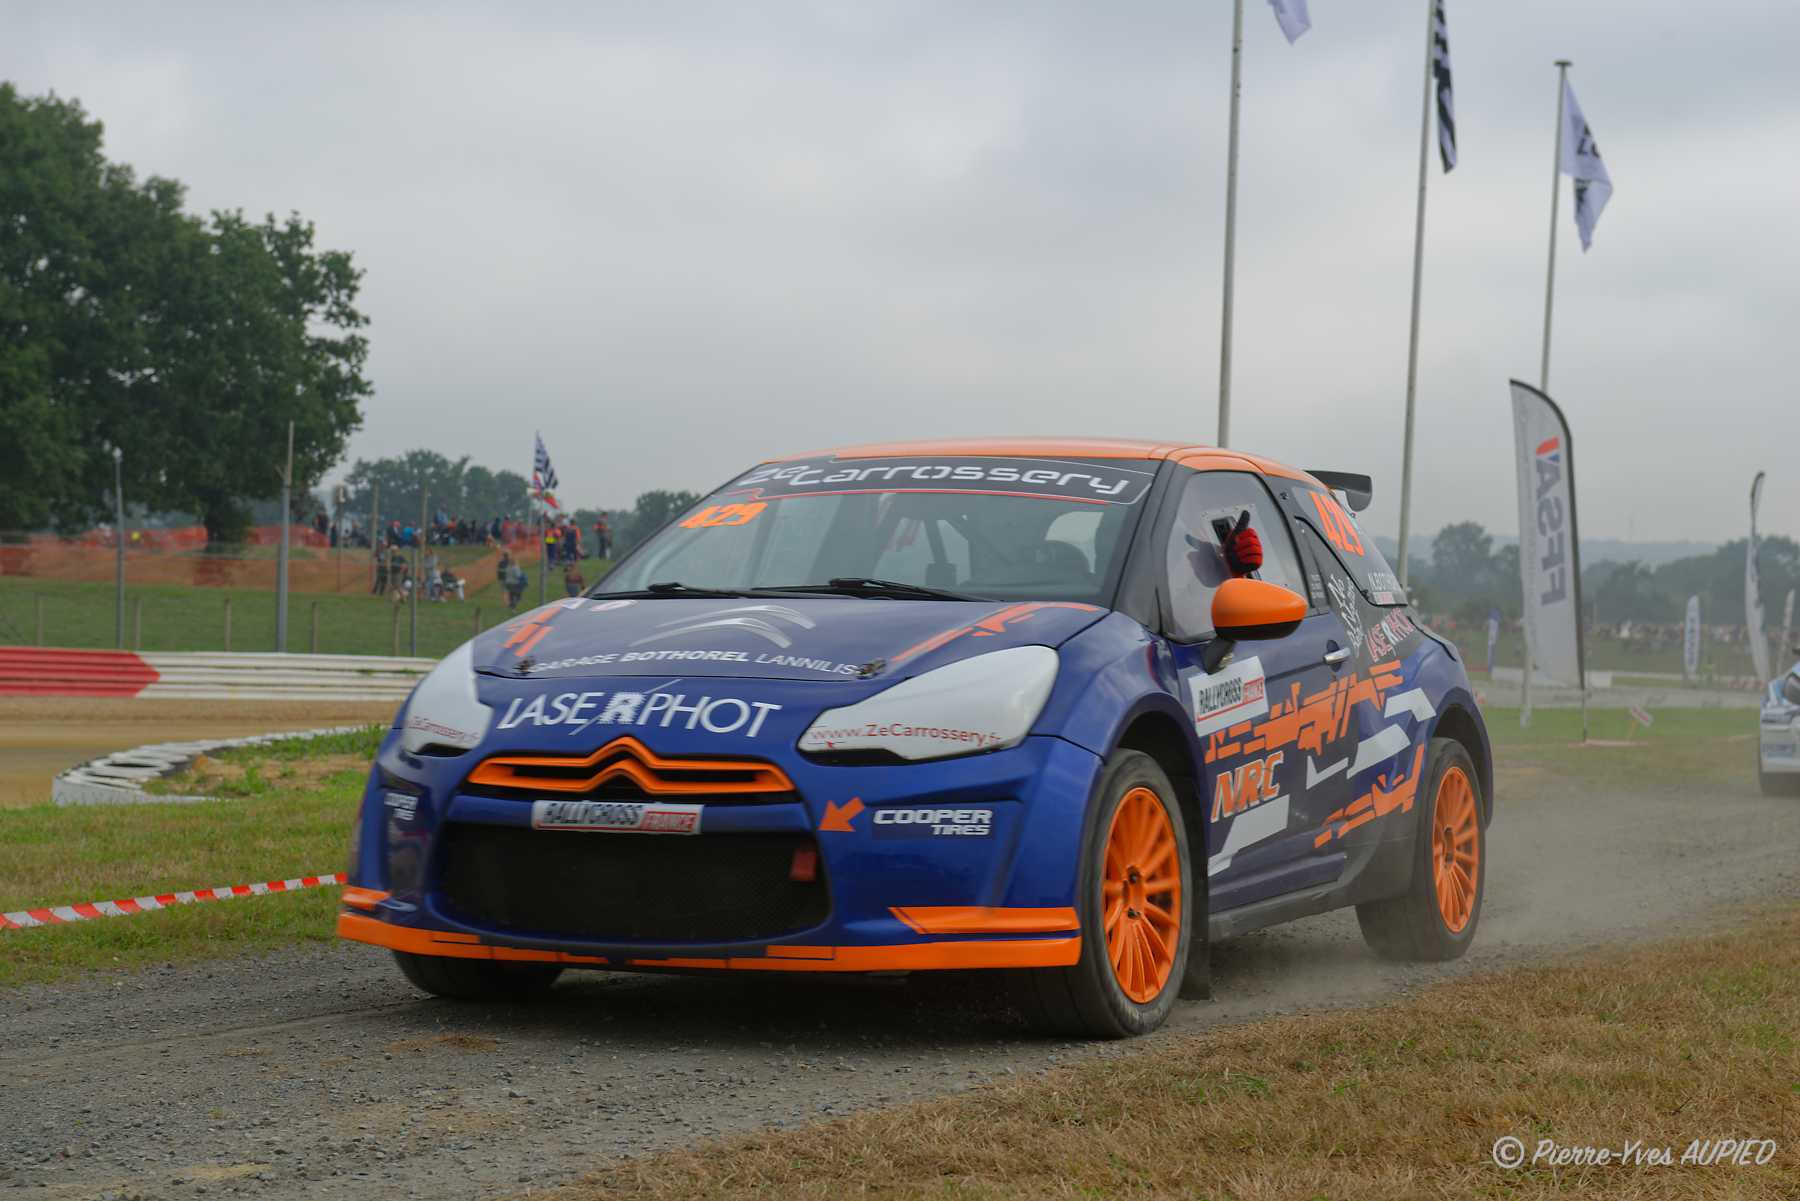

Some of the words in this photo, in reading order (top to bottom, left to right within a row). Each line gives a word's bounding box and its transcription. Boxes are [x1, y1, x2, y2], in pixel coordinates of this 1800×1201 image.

[678, 502, 768, 529] 429
[529, 653, 620, 673] GARAGE
[619, 650, 749, 662] BOTHOREL
[754, 653, 858, 675] LANNILIS
[1210, 750, 1285, 824] NRC
[543, 802, 643, 825] RALLYCROSS
[873, 809, 993, 825] COOPER
[931, 824, 991, 836] TIRES
